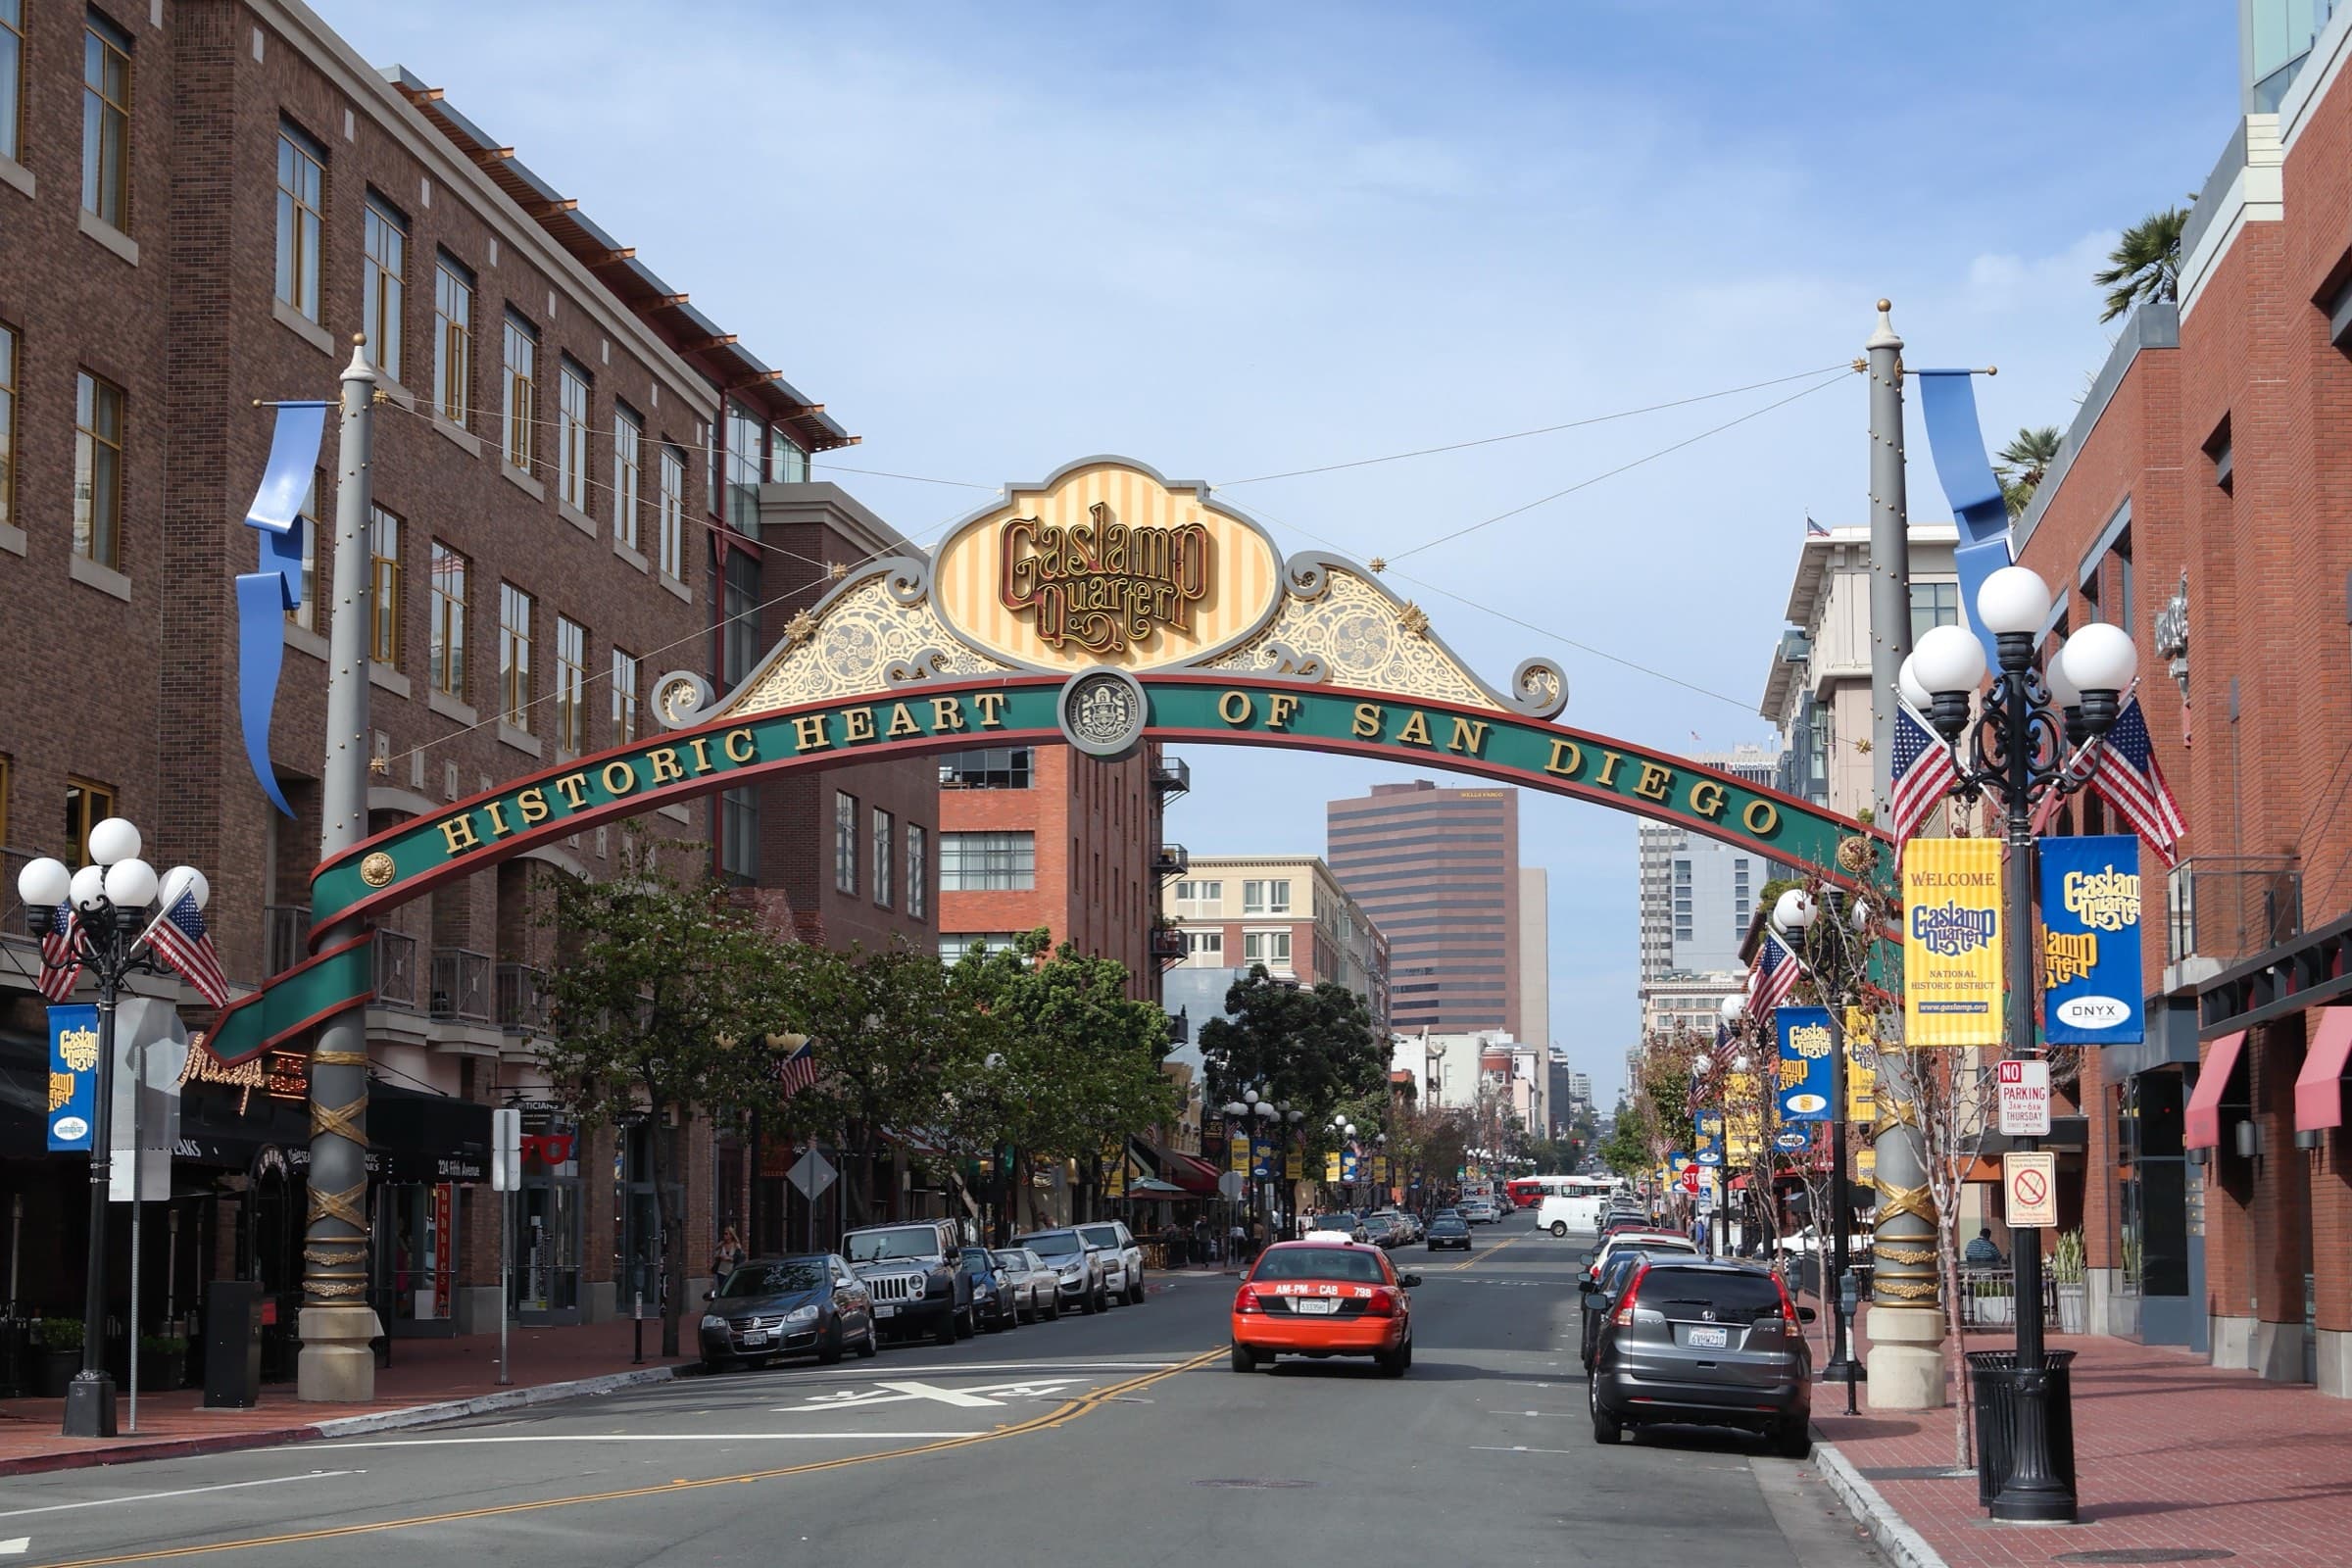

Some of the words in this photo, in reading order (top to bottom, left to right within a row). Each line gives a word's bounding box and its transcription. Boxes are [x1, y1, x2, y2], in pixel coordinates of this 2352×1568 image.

[999, 501, 1207, 631] Gaslamp
[1033, 576, 1178, 654] Quarter
[437, 728, 755, 855] HISTORIC
[792, 693, 1004, 751] HEART
[1218, 690, 1298, 727] OF
[1351, 703, 1489, 754] SAN
[1544, 738, 1778, 834] DIEGO
[1910, 872, 1996, 887] WELCOME
[1912, 900, 1995, 949] Gaslamp
[1926, 929, 1987, 956] Quarter
[1911, 981, 1951, 990] HISTORIC
[1954, 981, 1995, 990] DISTRICT
[1920, 1003, 1987, 1014] www.gaslamp.org
[2072, 1005, 2116, 1016] ONYX
[2002, 1064, 2020, 1081] NO
[2003, 1087, 2045, 1101] PARKING
[2007, 1111, 2042, 1121] THURSDAY
[438, 1159, 449, 1175] 224
[450, 1159, 462, 1176] Fifth
[462, 1162, 480, 1177] Avenue
[1275, 1284, 1308, 1295] AM-PM
[1319, 1285, 1339, 1296] CAB
